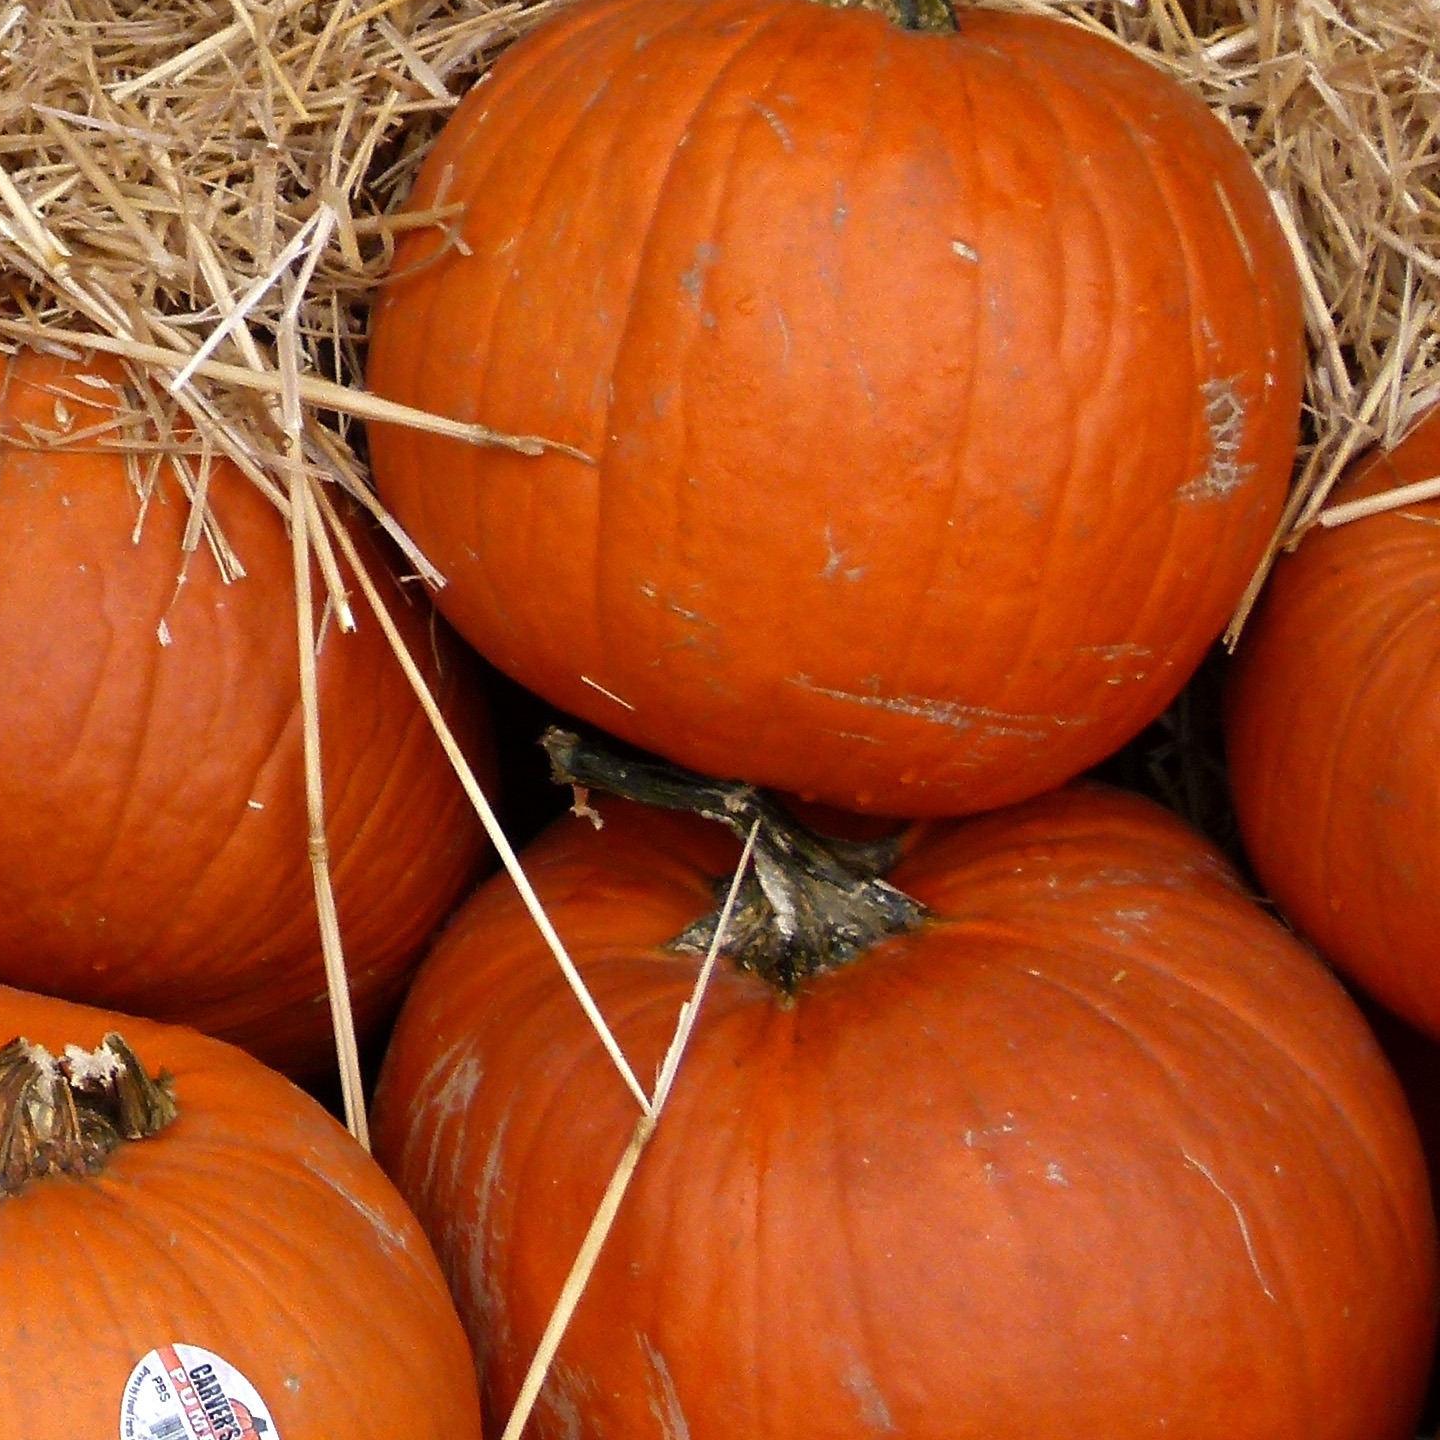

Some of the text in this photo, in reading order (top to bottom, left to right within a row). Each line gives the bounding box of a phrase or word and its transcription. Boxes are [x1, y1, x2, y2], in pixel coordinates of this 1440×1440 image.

[152, 1375, 170, 1403] PBS
[170, 1367, 214, 1440] PUM
[189, 1363, 243, 1440] CARVER'S
